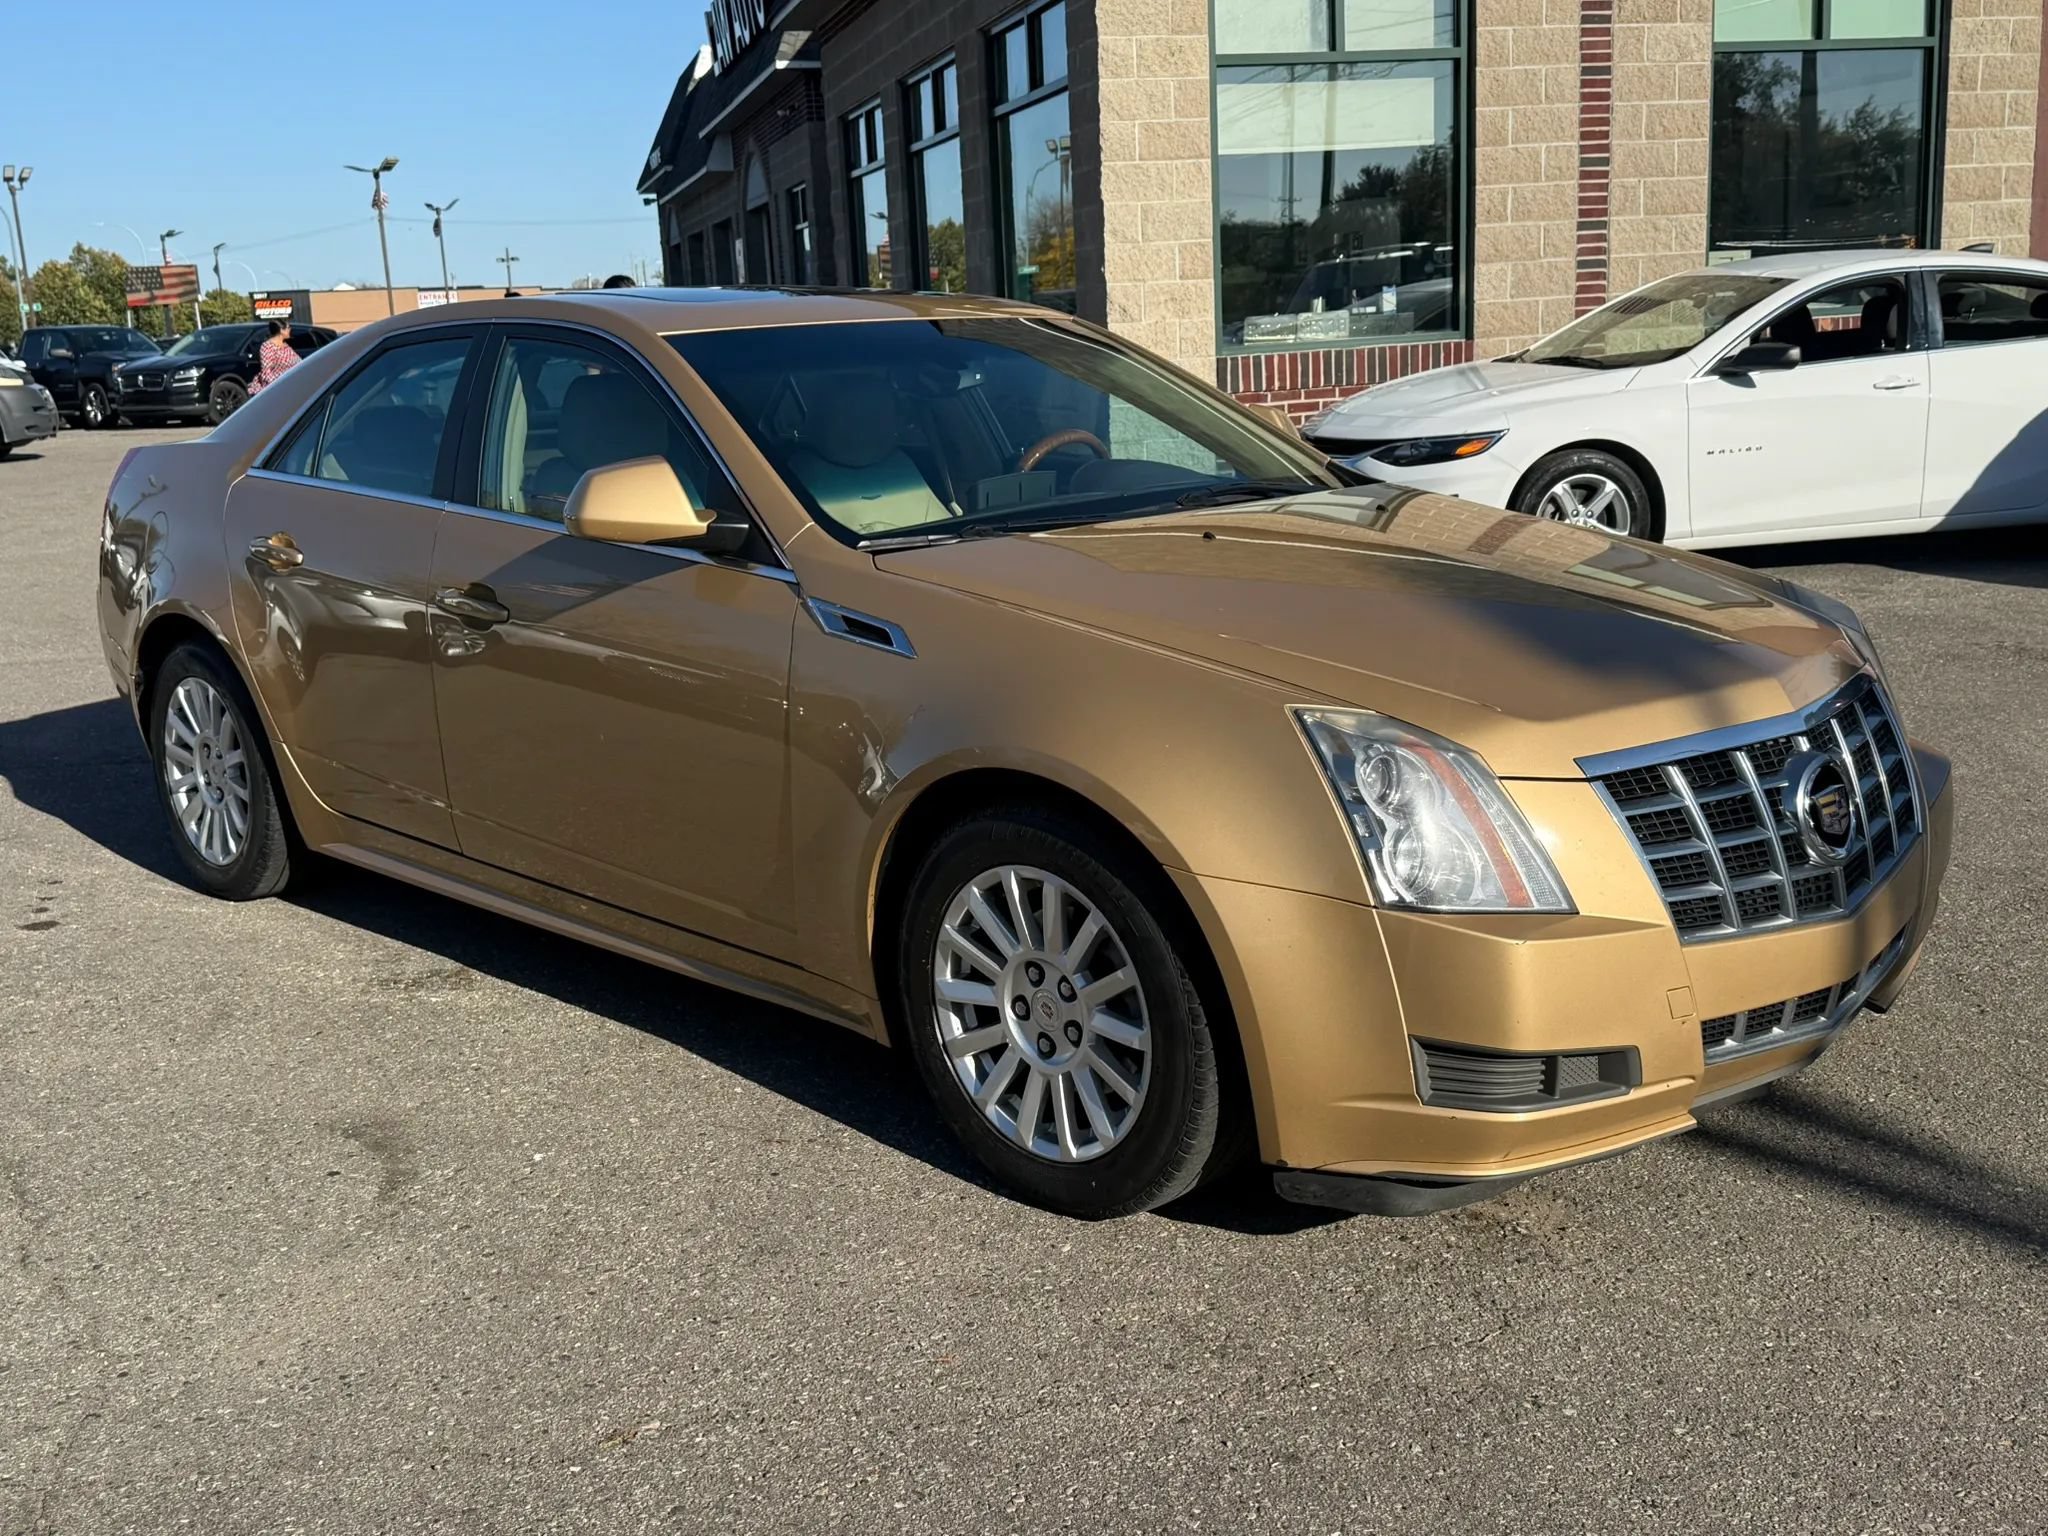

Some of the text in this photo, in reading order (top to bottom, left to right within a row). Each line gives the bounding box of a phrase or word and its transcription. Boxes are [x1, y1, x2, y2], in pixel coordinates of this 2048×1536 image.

[419, 293, 457, 301] ENTRANE
[255, 307, 292, 316] MOTORS
[1706, 446, 1763, 455] MALIBU
